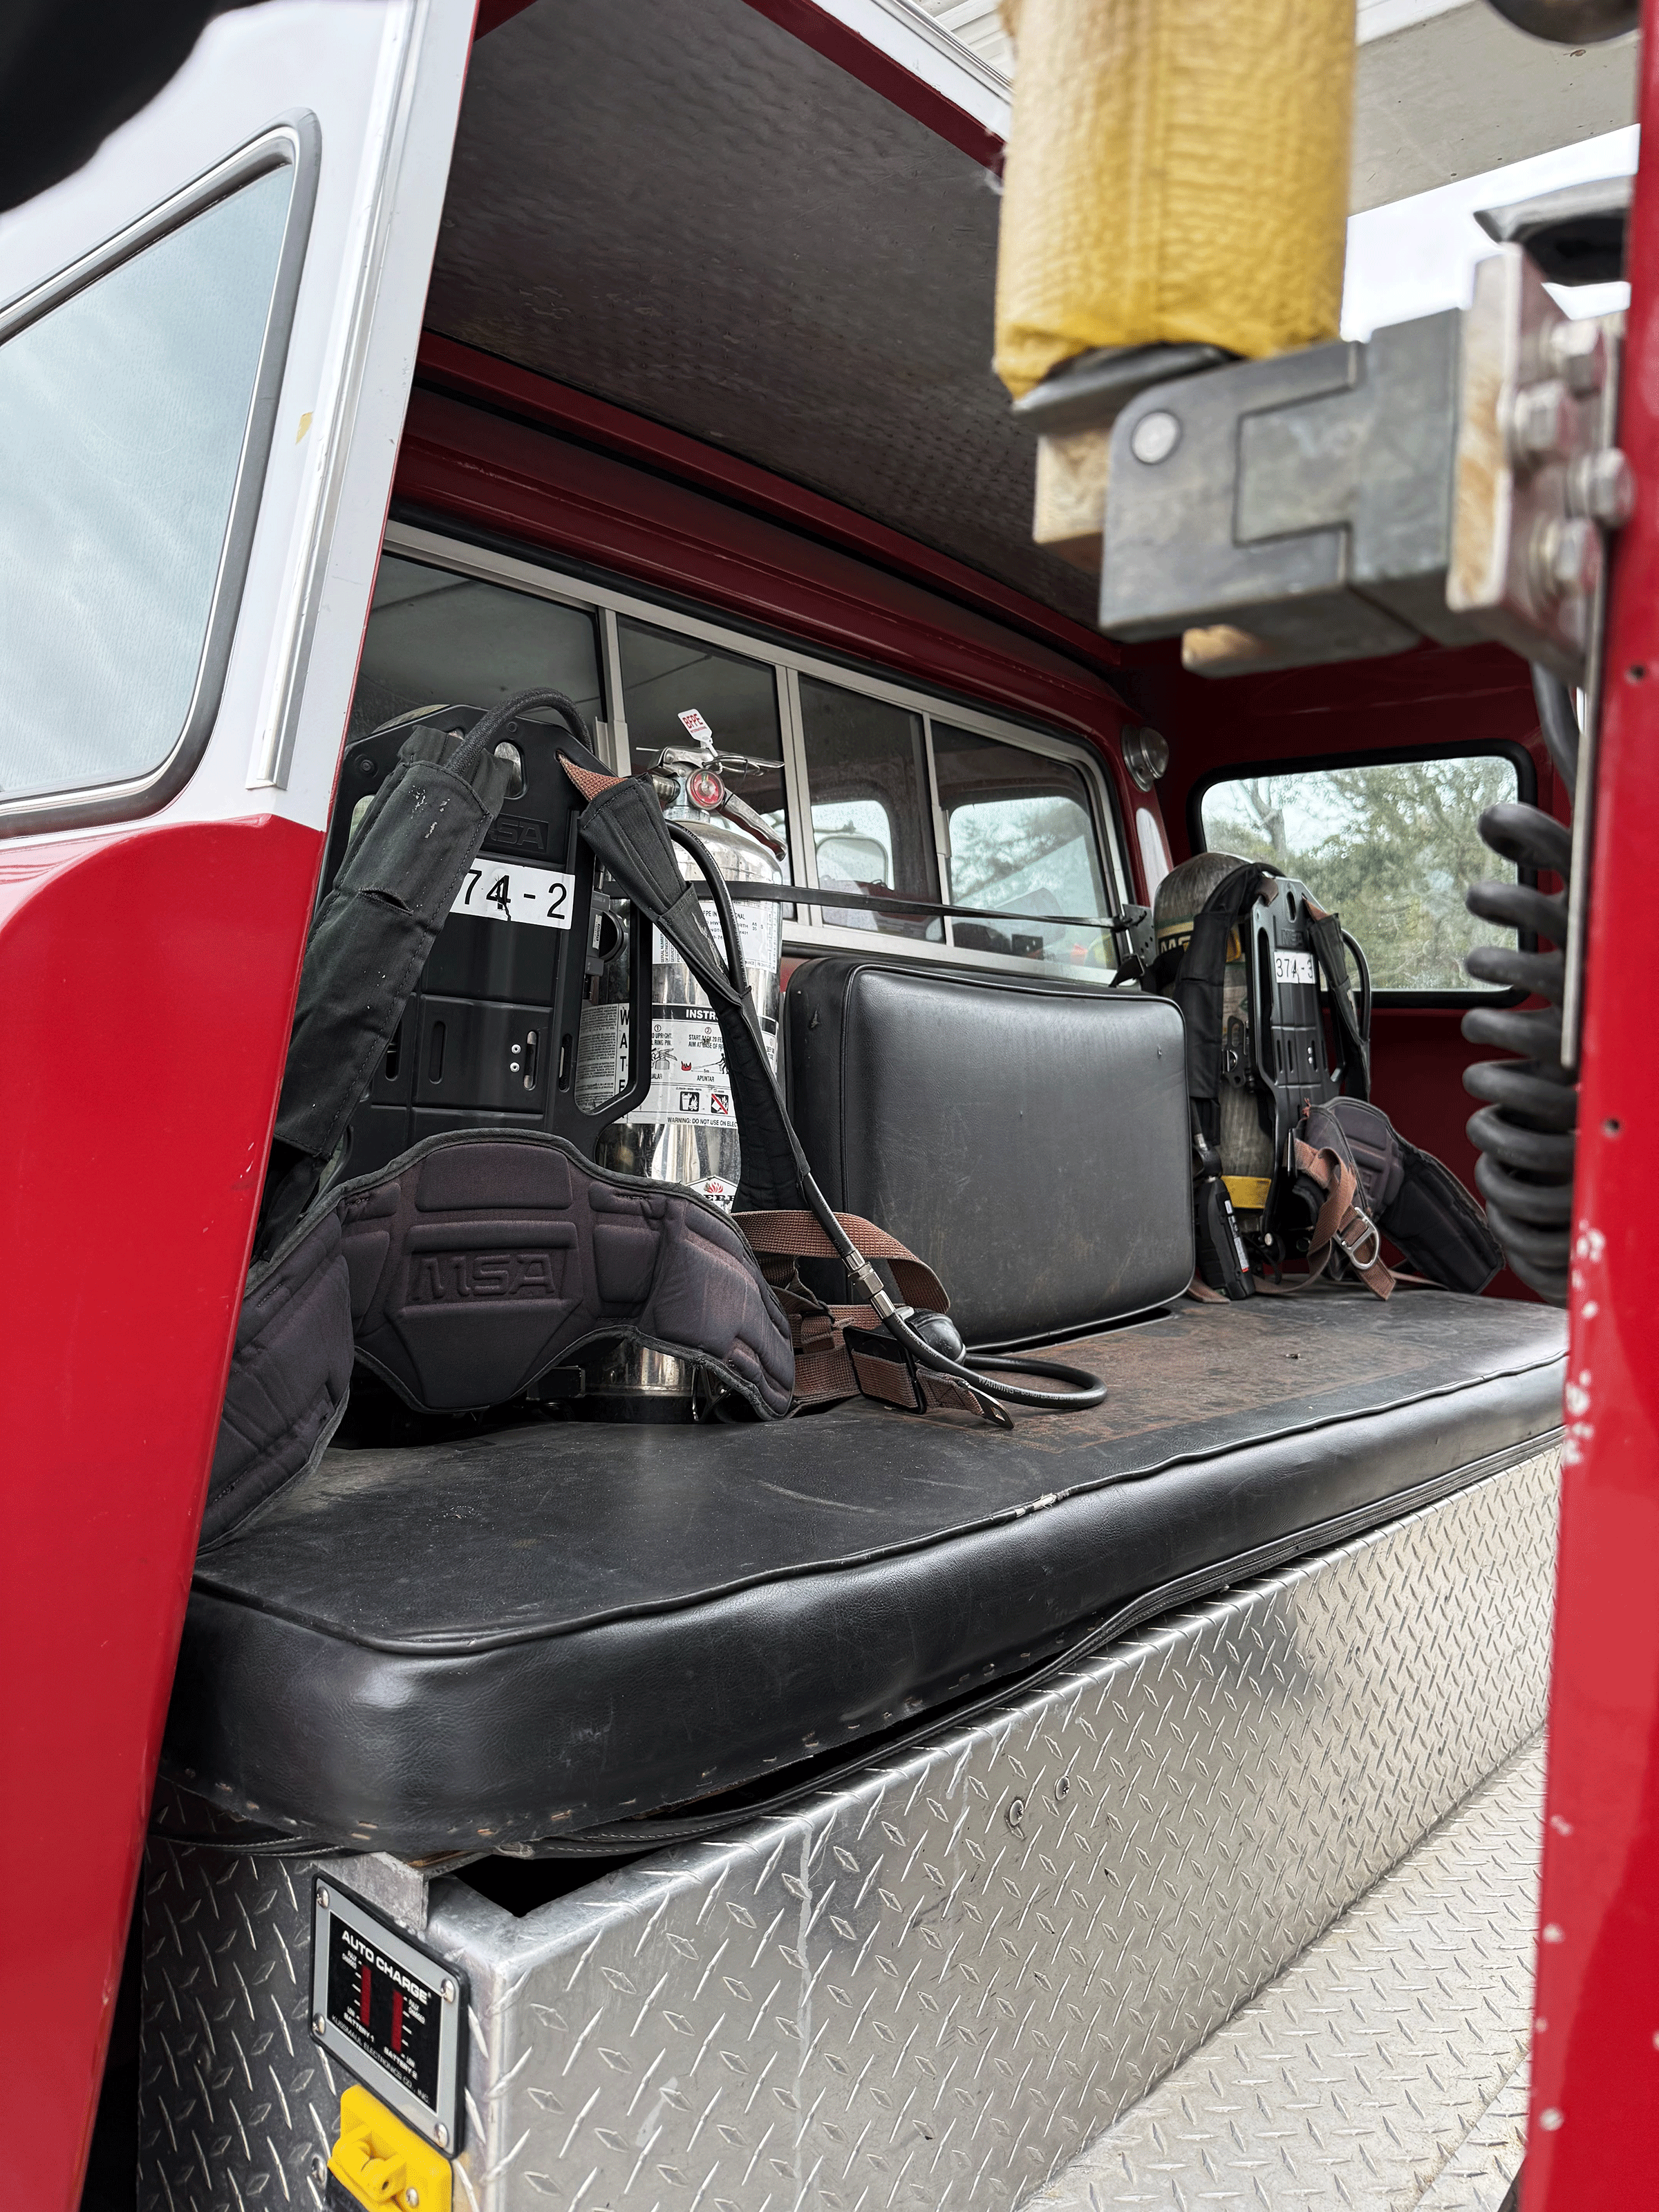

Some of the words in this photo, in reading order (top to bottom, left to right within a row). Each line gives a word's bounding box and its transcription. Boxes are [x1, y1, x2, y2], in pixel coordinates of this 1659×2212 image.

[683, 714, 703, 728] BFPE
[488, 818, 545, 850] SA
[1276, 958, 1313, 979] 374-3
[412, 1254, 555, 1300] MSA
[979, 1377, 1014, 1394] WARNING
[341, 1930, 375, 1964] AUTO
[376, 1956, 428, 2005] CHARGE
[344, 2012, 371, 2038] BATTERY
[364, 2041, 403, 2082] ELECTRONICS
[384, 2046, 413, 2076] BATTERY
